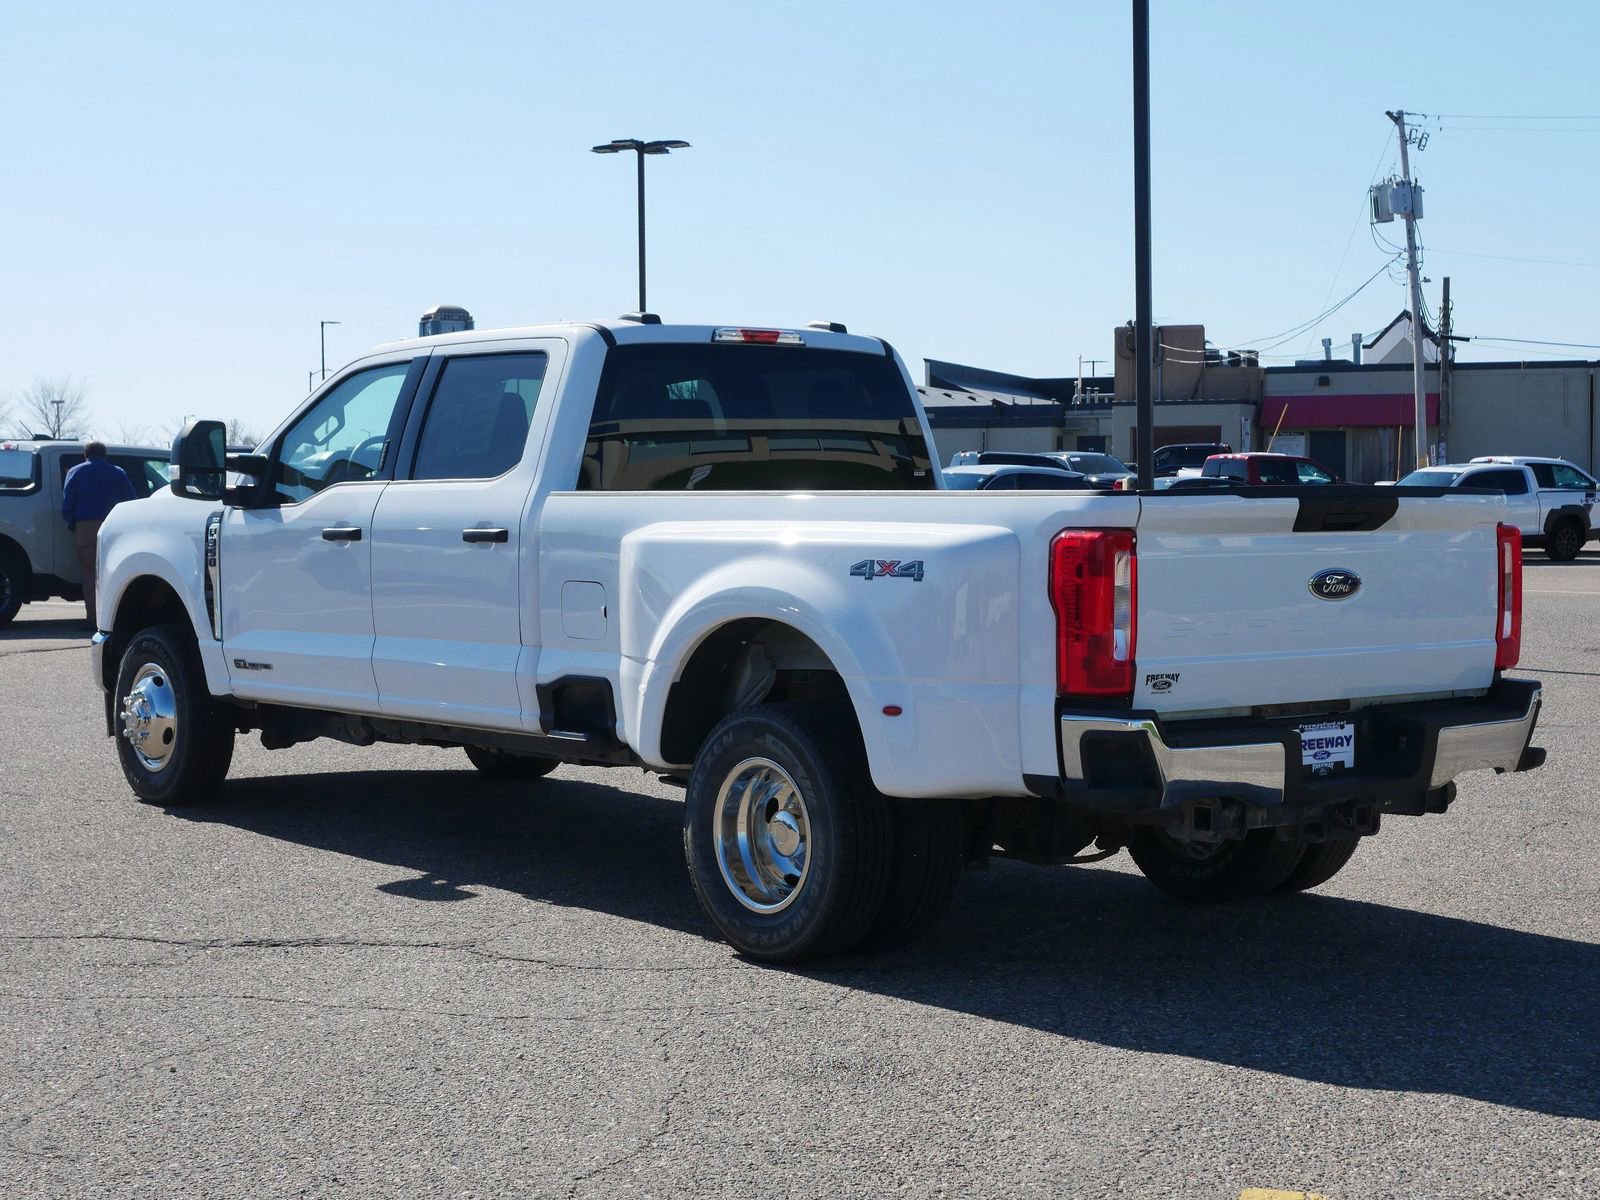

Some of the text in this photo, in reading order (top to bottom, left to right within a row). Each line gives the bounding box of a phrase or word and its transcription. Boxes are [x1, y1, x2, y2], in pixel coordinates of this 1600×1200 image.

[1323, 575, 1351, 593] Ford
[1145, 673, 1180, 686] FREEWAY
[1301, 735, 1352, 751] REEWAY
